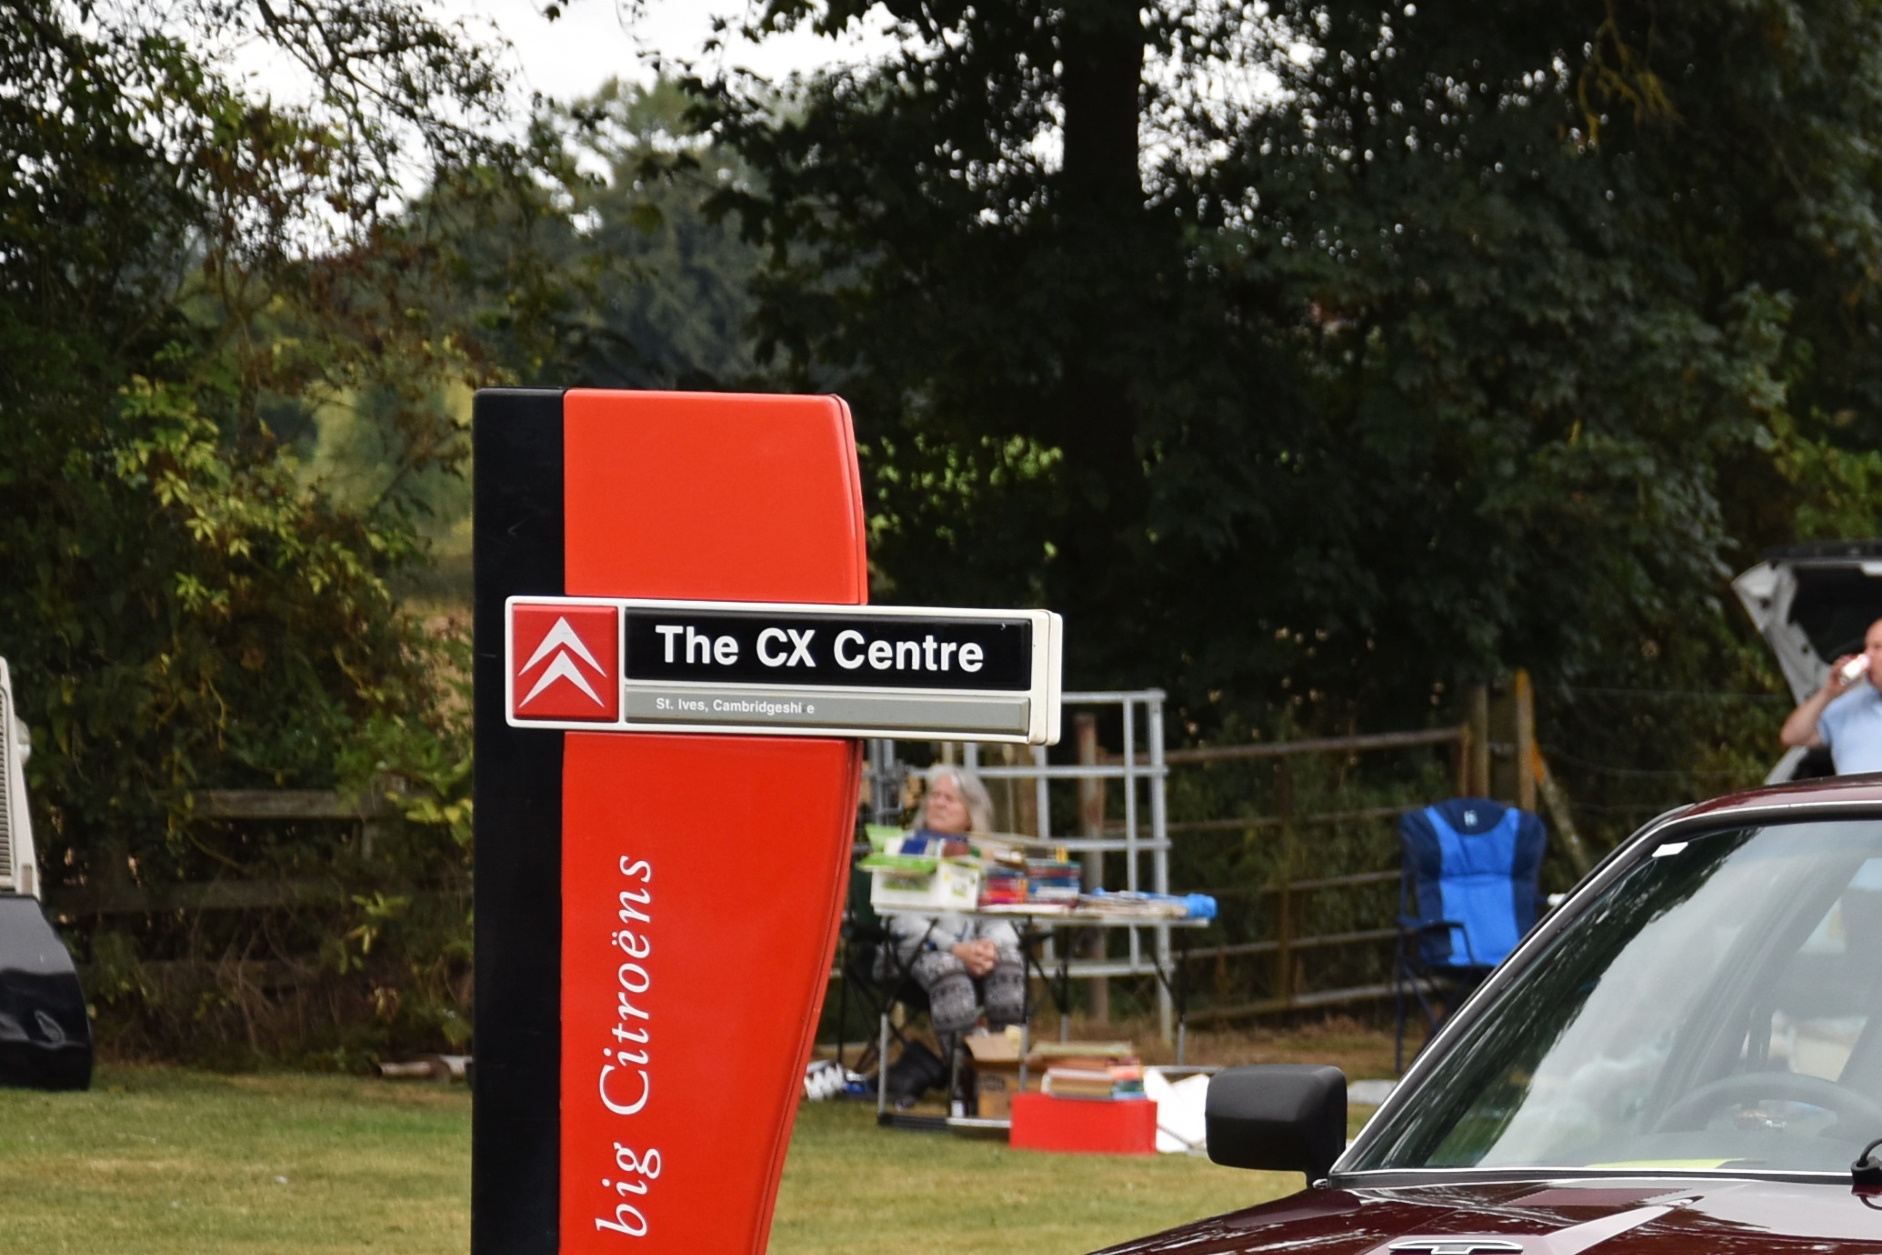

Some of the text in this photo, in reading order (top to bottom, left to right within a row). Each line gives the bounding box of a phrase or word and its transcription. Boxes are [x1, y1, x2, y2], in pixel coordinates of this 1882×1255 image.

[655, 625, 984, 673] The CX Centre
[656, 697, 815, 716] St. Ives, Cambridgeshie
[599, 855, 652, 1116] Citroëns
[595, 1141, 661, 1237] big
